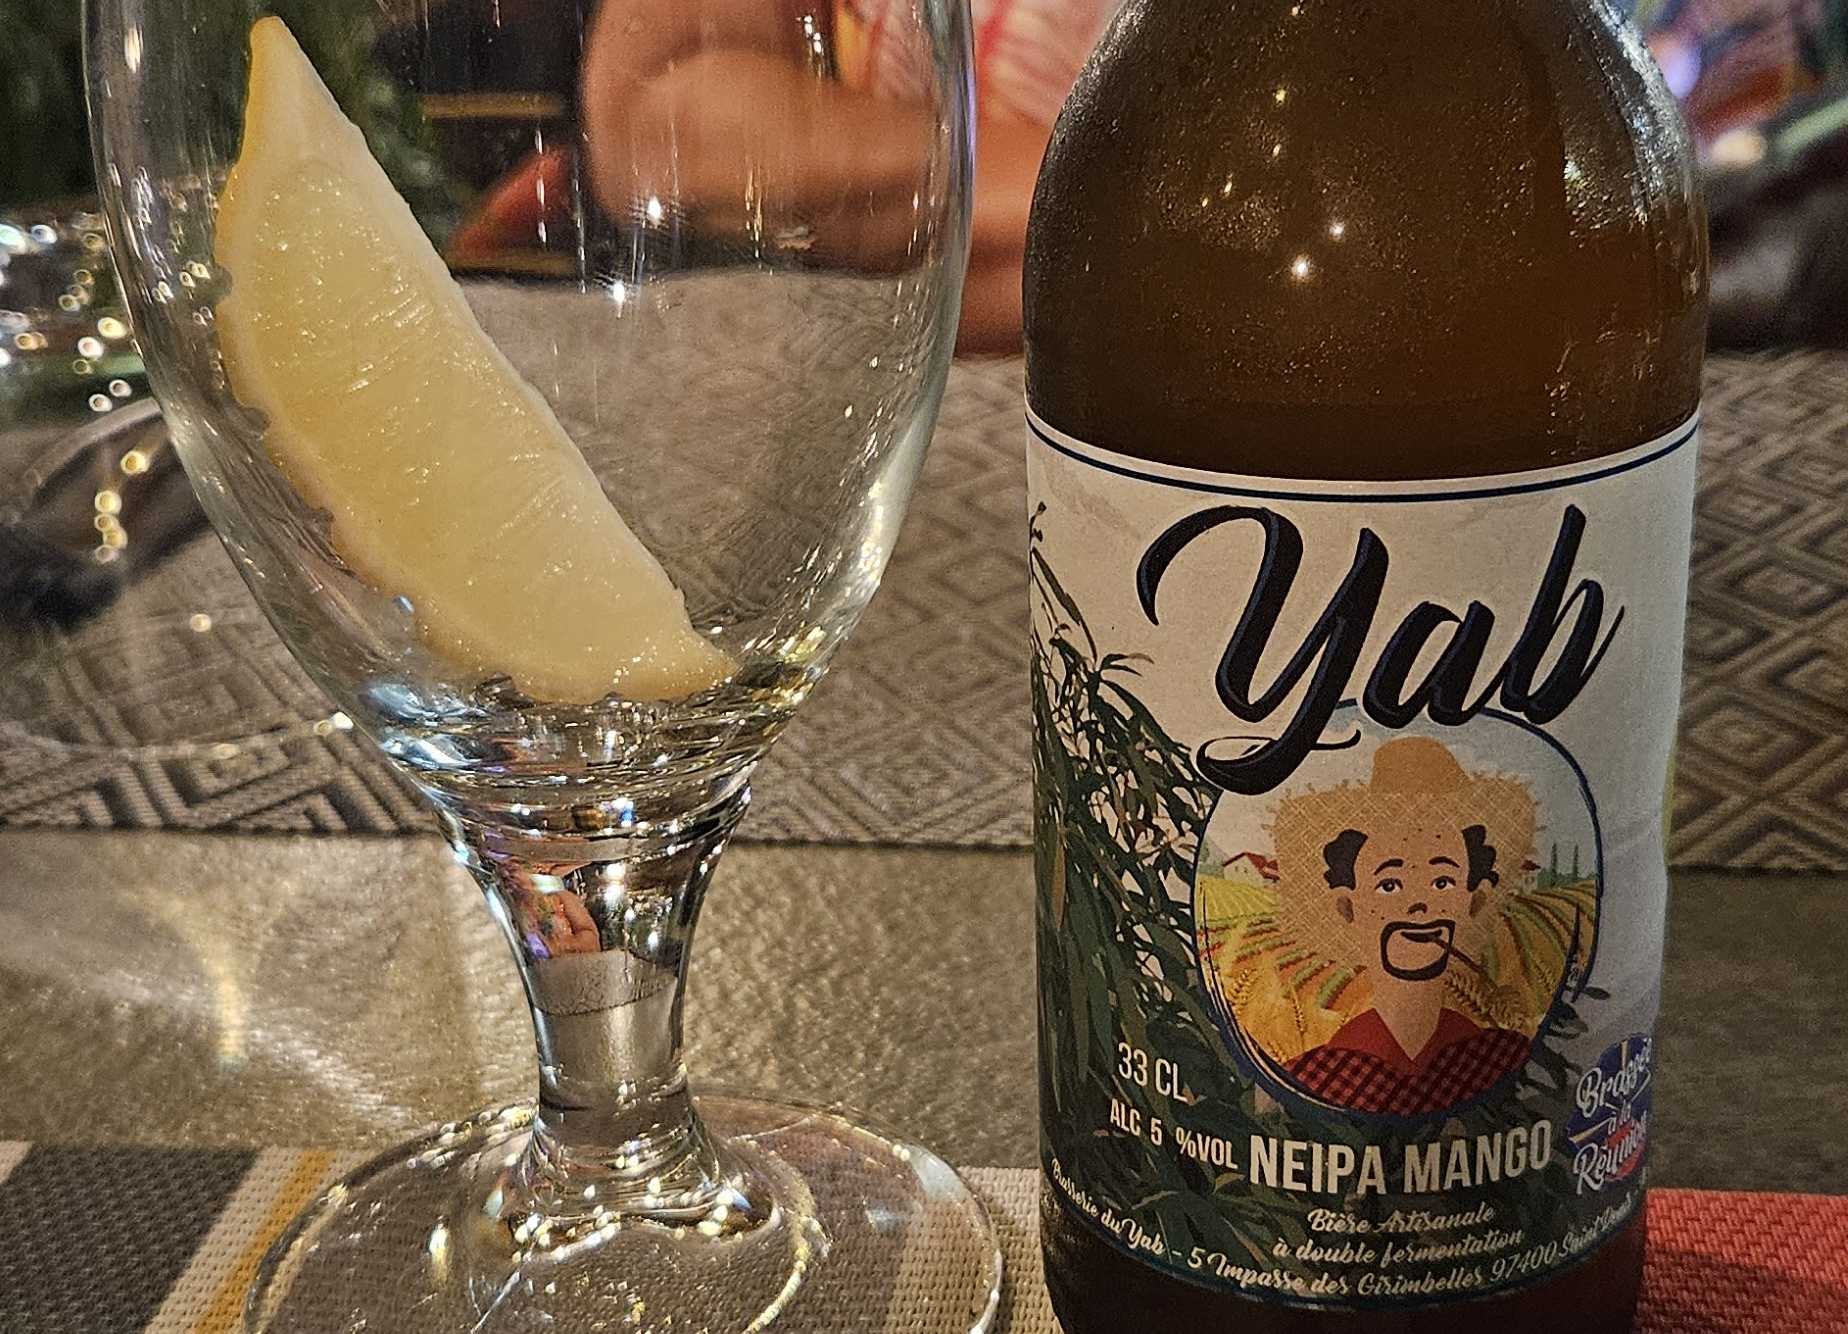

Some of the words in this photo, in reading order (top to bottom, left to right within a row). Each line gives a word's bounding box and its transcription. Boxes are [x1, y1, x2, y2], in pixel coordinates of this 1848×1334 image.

[1136, 504, 1623, 795] Yab
[1118, 1041, 1148, 1087] 33
[1155, 1058, 1188, 1102] CL
[1109, 1098, 1142, 1137] ALC
[1150, 1117, 1163, 1146] 5
[1249, 1134, 1387, 1195] NEIPA
[1403, 1119, 1551, 1194] MANGO
[1307, 1208, 1372, 1234] Bière
[1373, 1201, 1495, 1234] Artisanale
[1100, 1208, 1123, 1234] du
[1121, 1218, 1166, 1255] Yab
[1187, 1246, 1206, 1268] 5
[1207, 1253, 1310, 1292] Impasse
[1310, 1272, 1350, 1296] des
[1357, 1268, 1483, 1296] Girimbelles
[1489, 1240, 1558, 1282] 97400
[1272, 1237, 1290, 1259] à
[1295, 1238, 1377, 1264] double
[1378, 1228, 1525, 1269] fermentation
